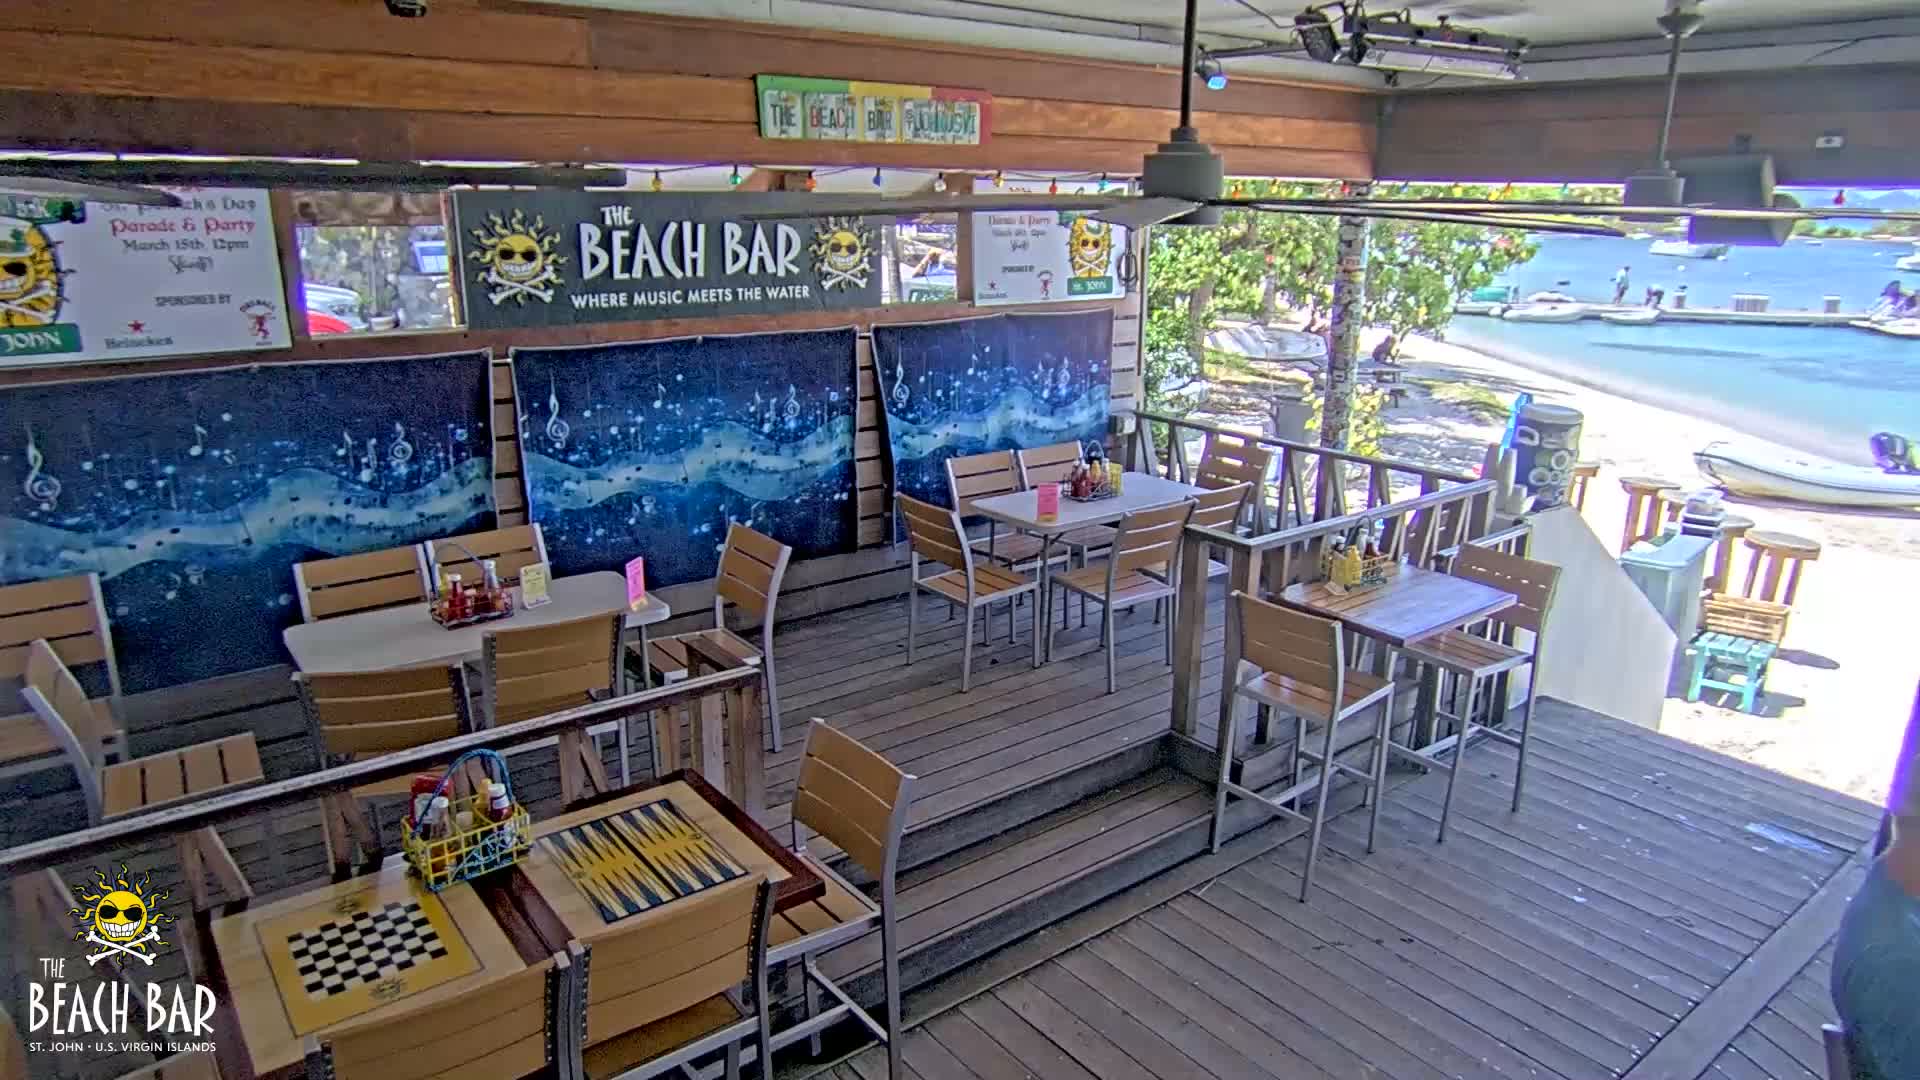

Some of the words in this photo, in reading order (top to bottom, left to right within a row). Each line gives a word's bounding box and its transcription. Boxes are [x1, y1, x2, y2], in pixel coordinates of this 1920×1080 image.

[810, 104, 856, 129] BEACH
[867, 109, 893, 131] BAR
[110, 216, 177, 237] Parade
[204, 216, 257, 236] Party
[600, 205, 634, 226] THE
[121, 238, 170, 253] March
[211, 238, 250, 252] 12pm
[579, 220, 707, 281] BEACH
[723, 221, 802, 277] BAR
[571, 292, 628, 309] WHERE
[633, 290, 683, 307] MUSIC
[688, 287, 733, 304] MEETS
[738, 286, 762, 301] THE
[766, 285, 811, 299] WATER
